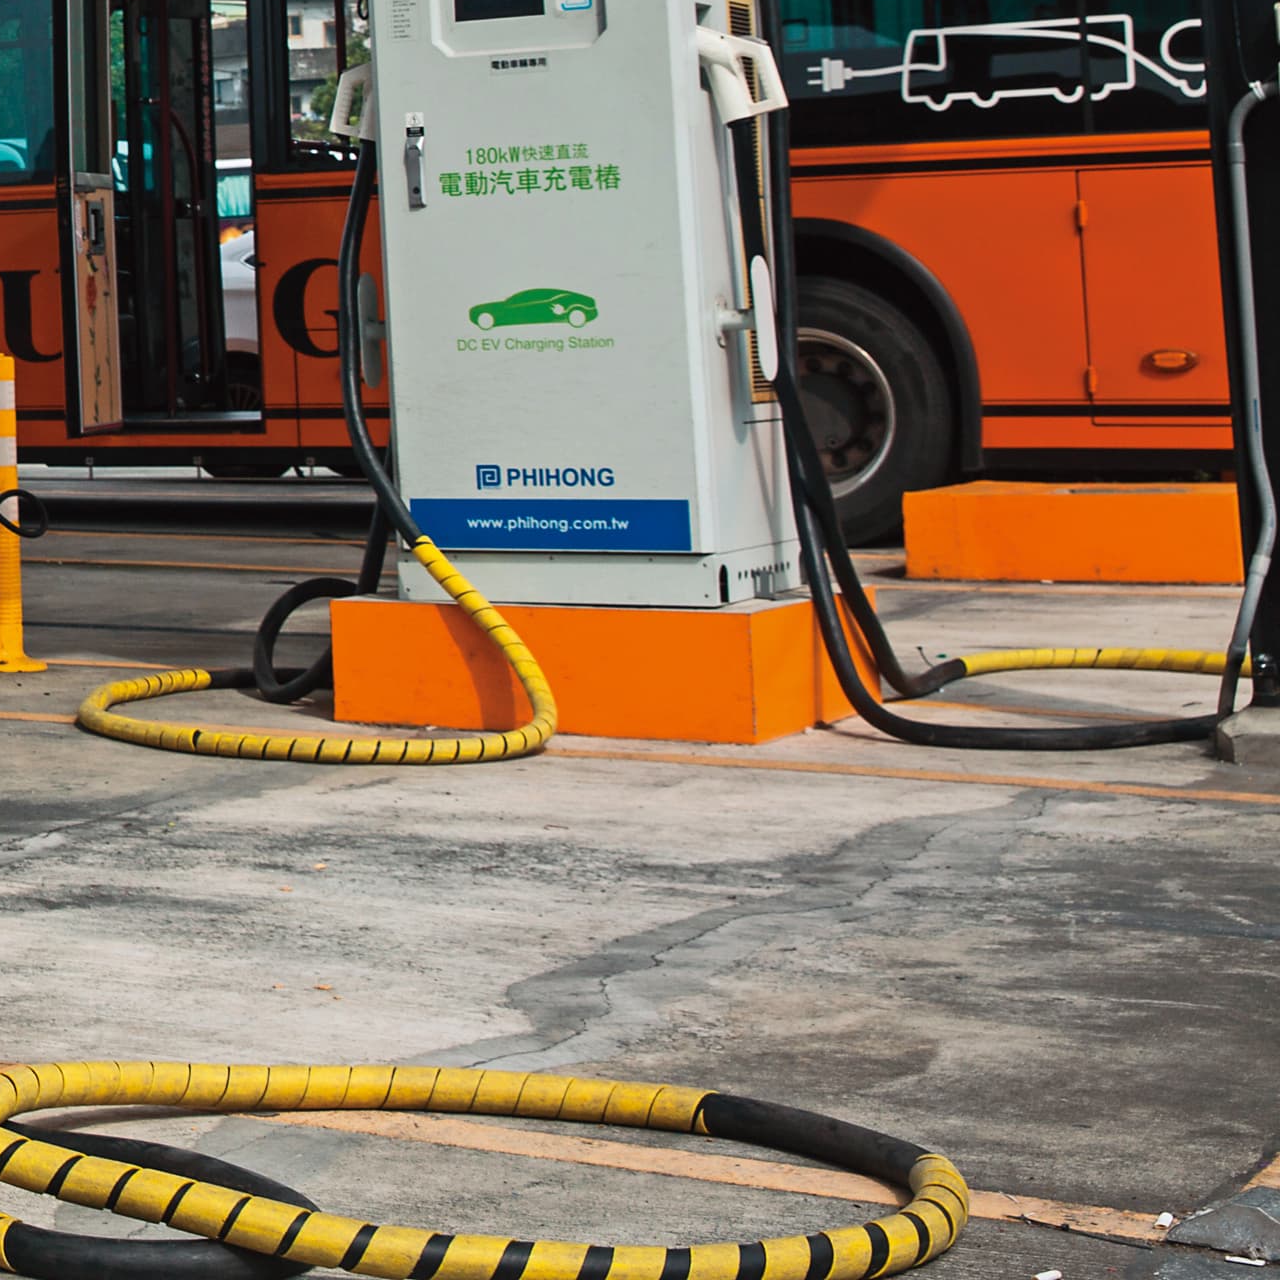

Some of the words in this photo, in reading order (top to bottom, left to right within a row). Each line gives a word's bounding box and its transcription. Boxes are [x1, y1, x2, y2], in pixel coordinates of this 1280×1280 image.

[439, 163, 621, 197] 電動汽車充電樁
[456, 338, 478, 351] DC
[481, 338, 501, 351] EV
[504, 337, 564, 352] Charging
[567, 336, 615, 349] Station
[507, 468, 615, 487] PHIHONG
[467, 516, 629, 533] www.phihong.com.tw
